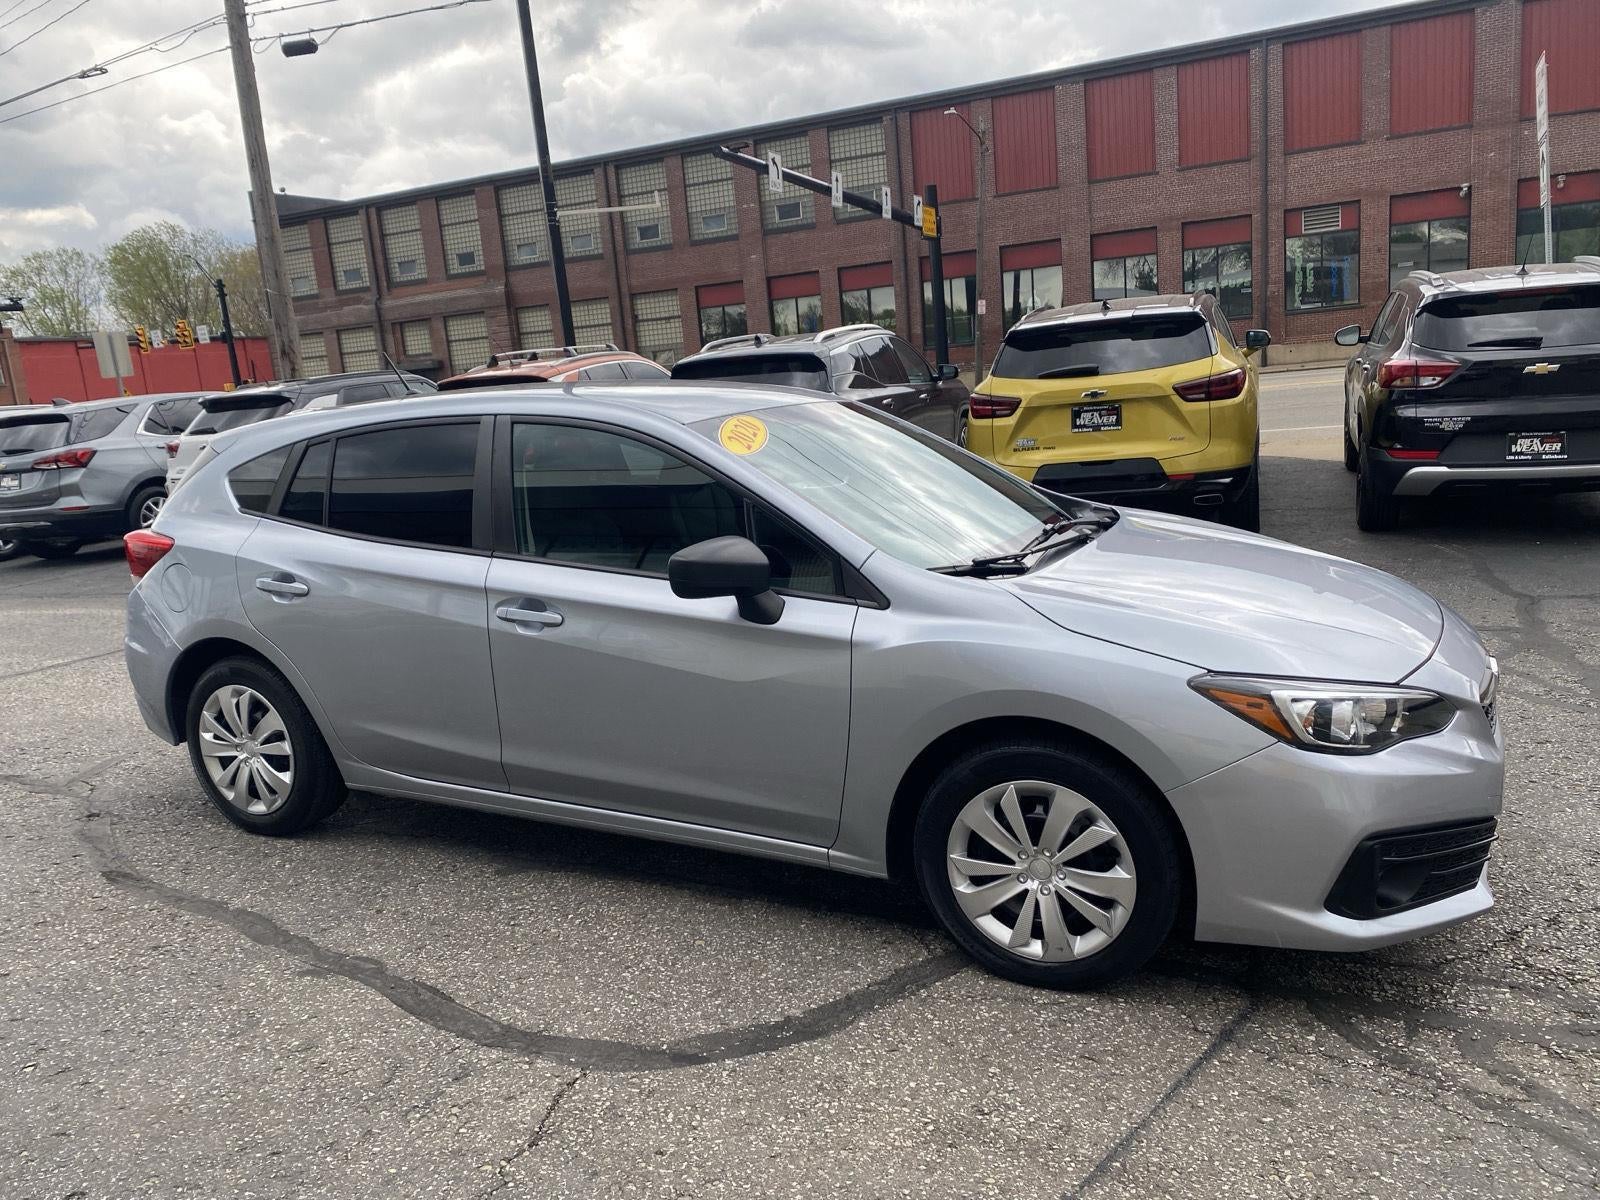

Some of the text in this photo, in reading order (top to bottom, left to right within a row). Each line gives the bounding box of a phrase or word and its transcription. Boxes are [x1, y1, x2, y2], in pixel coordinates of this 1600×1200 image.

[1080, 411, 1100, 419] RICK
[1076, 415, 1117, 426] WEAVER
[727, 418, 761, 451] 2020
[1517, 438, 1541, 446] RICK
[1511, 443, 1561, 453] WEAVER
